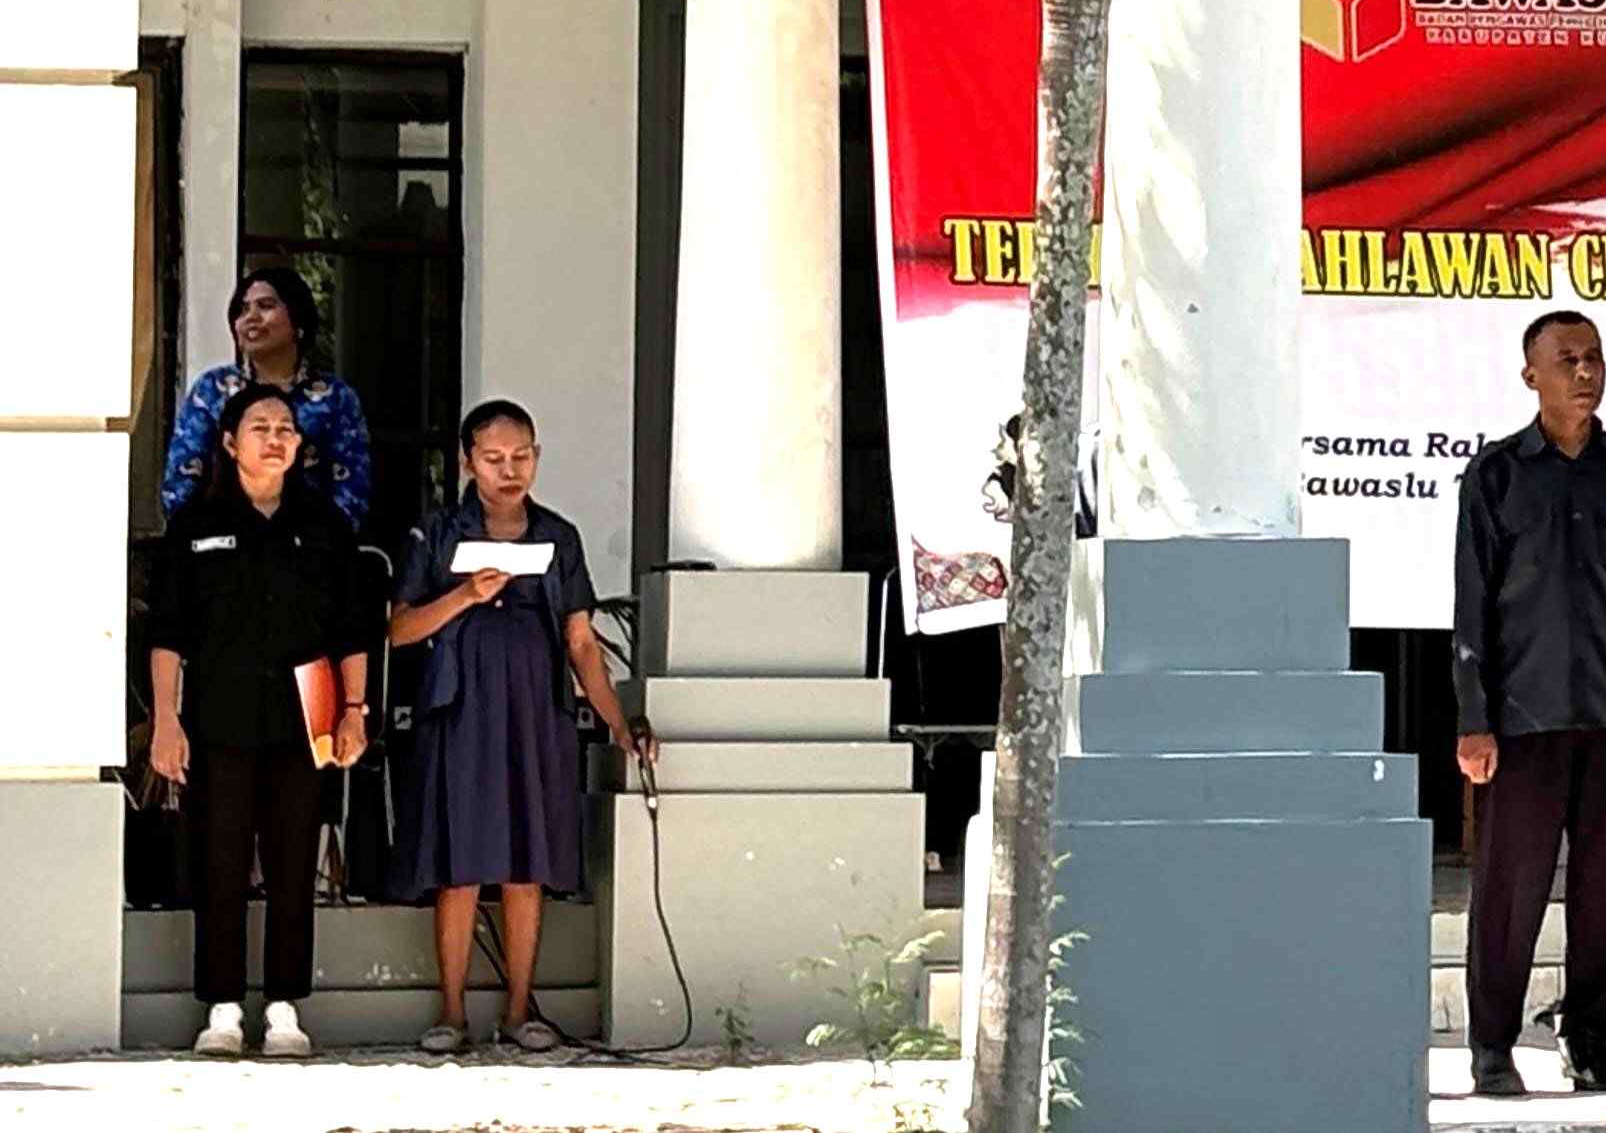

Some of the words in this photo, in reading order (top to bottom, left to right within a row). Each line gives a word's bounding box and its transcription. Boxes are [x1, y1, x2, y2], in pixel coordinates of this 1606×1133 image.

[1426, 27, 1568, 45] KABUPATEN
[1301, 227, 1552, 299] AHLAWAN
[1302, 433, 1412, 457] rsama
[1302, 472, 1439, 499] awaslu
